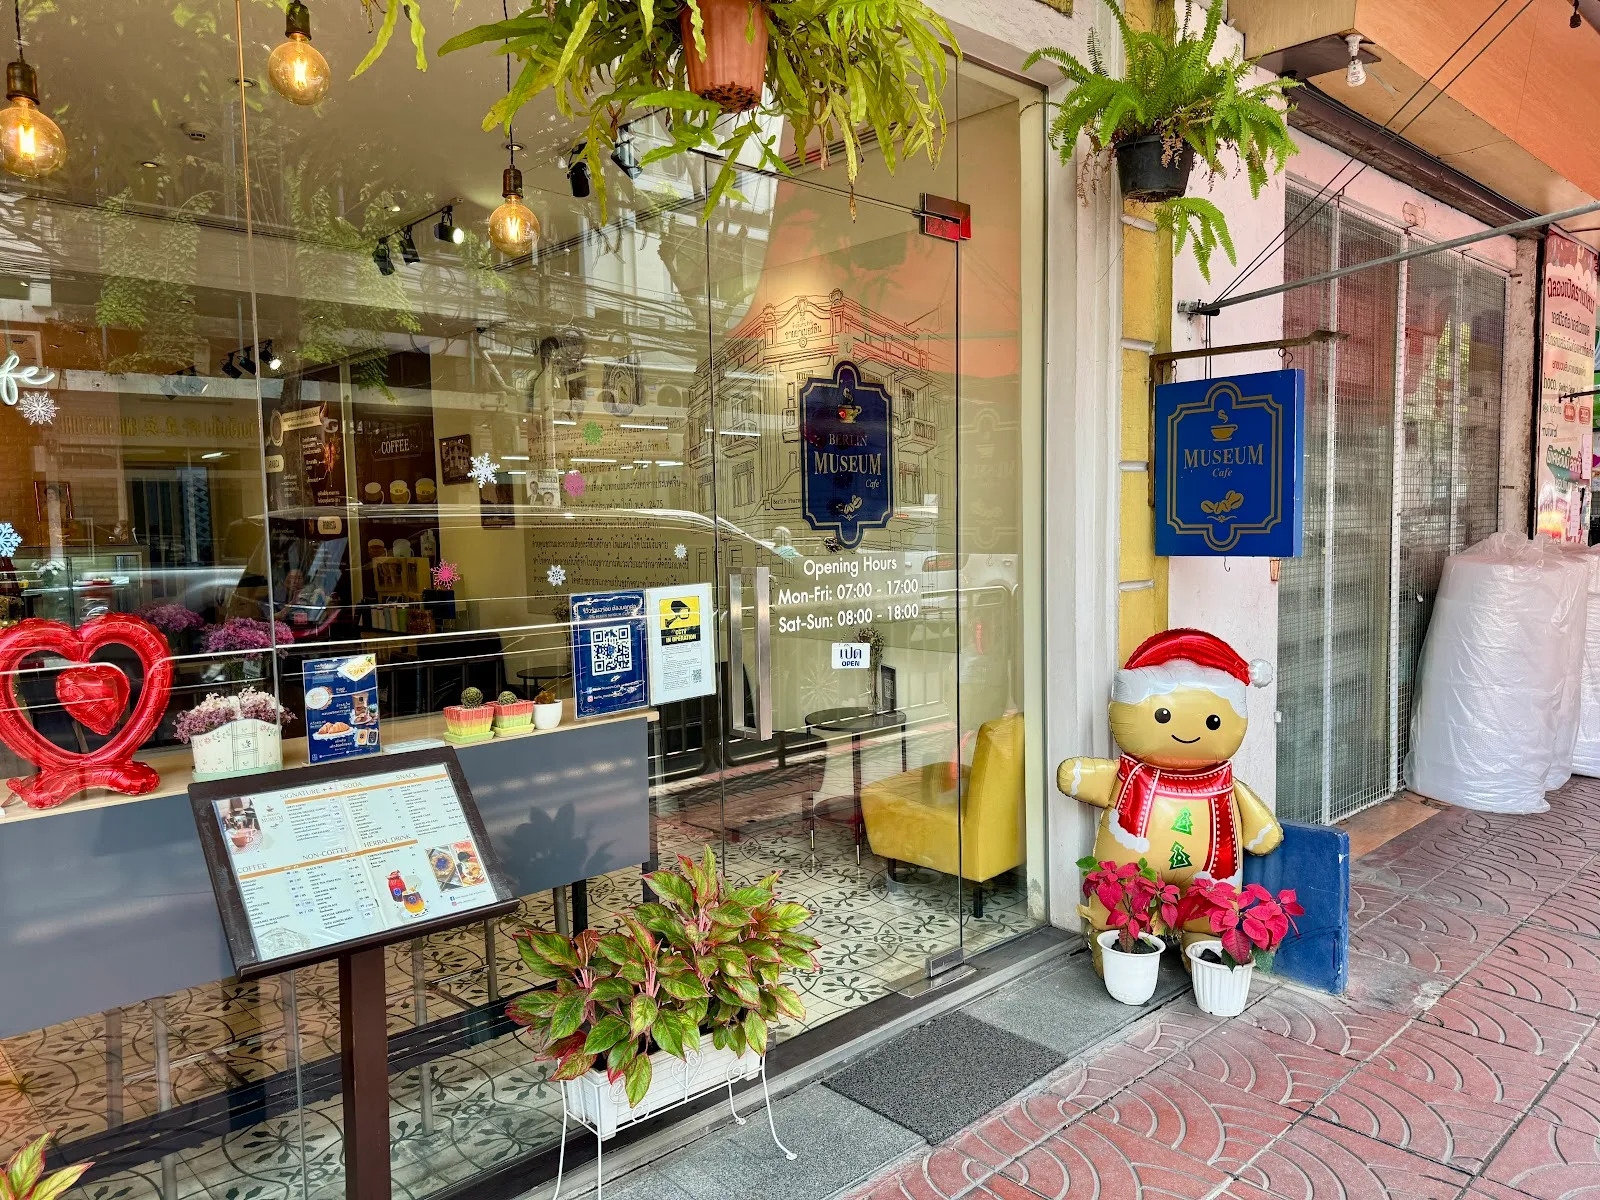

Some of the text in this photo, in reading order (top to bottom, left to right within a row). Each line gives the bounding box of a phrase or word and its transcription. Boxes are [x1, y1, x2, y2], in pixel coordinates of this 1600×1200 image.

[381, 438, 410, 454] COFFEE
[829, 433, 868, 447] BERLIN
[814, 451, 882, 475] MUSEUM
[1184, 443, 1264, 470] MUSEUM
[1212, 467, 1233, 478] Cafe
[803, 556, 898, 580] Opening Hours
[778, 585, 833, 605] Mon-Fri:
[837, 582, 872, 600] 07:00
[886, 578, 918, 595] 17:00
[779, 614, 833, 633] Sat-Sun:
[837, 608, 873, 626] 08:00
[887, 603, 919, 621] 18:00
[672, 633, 697, 642] OPERATION
[839, 643, 862, 660] เปิด
[396, 772, 419, 780] SNACK
[280, 788, 321, 800] SIGNATURE
[363, 834, 411, 848] HERBAL DRINK
[302, 846, 349, 860] NON-COFFEE
[236, 863, 268, 874] COFFEE
